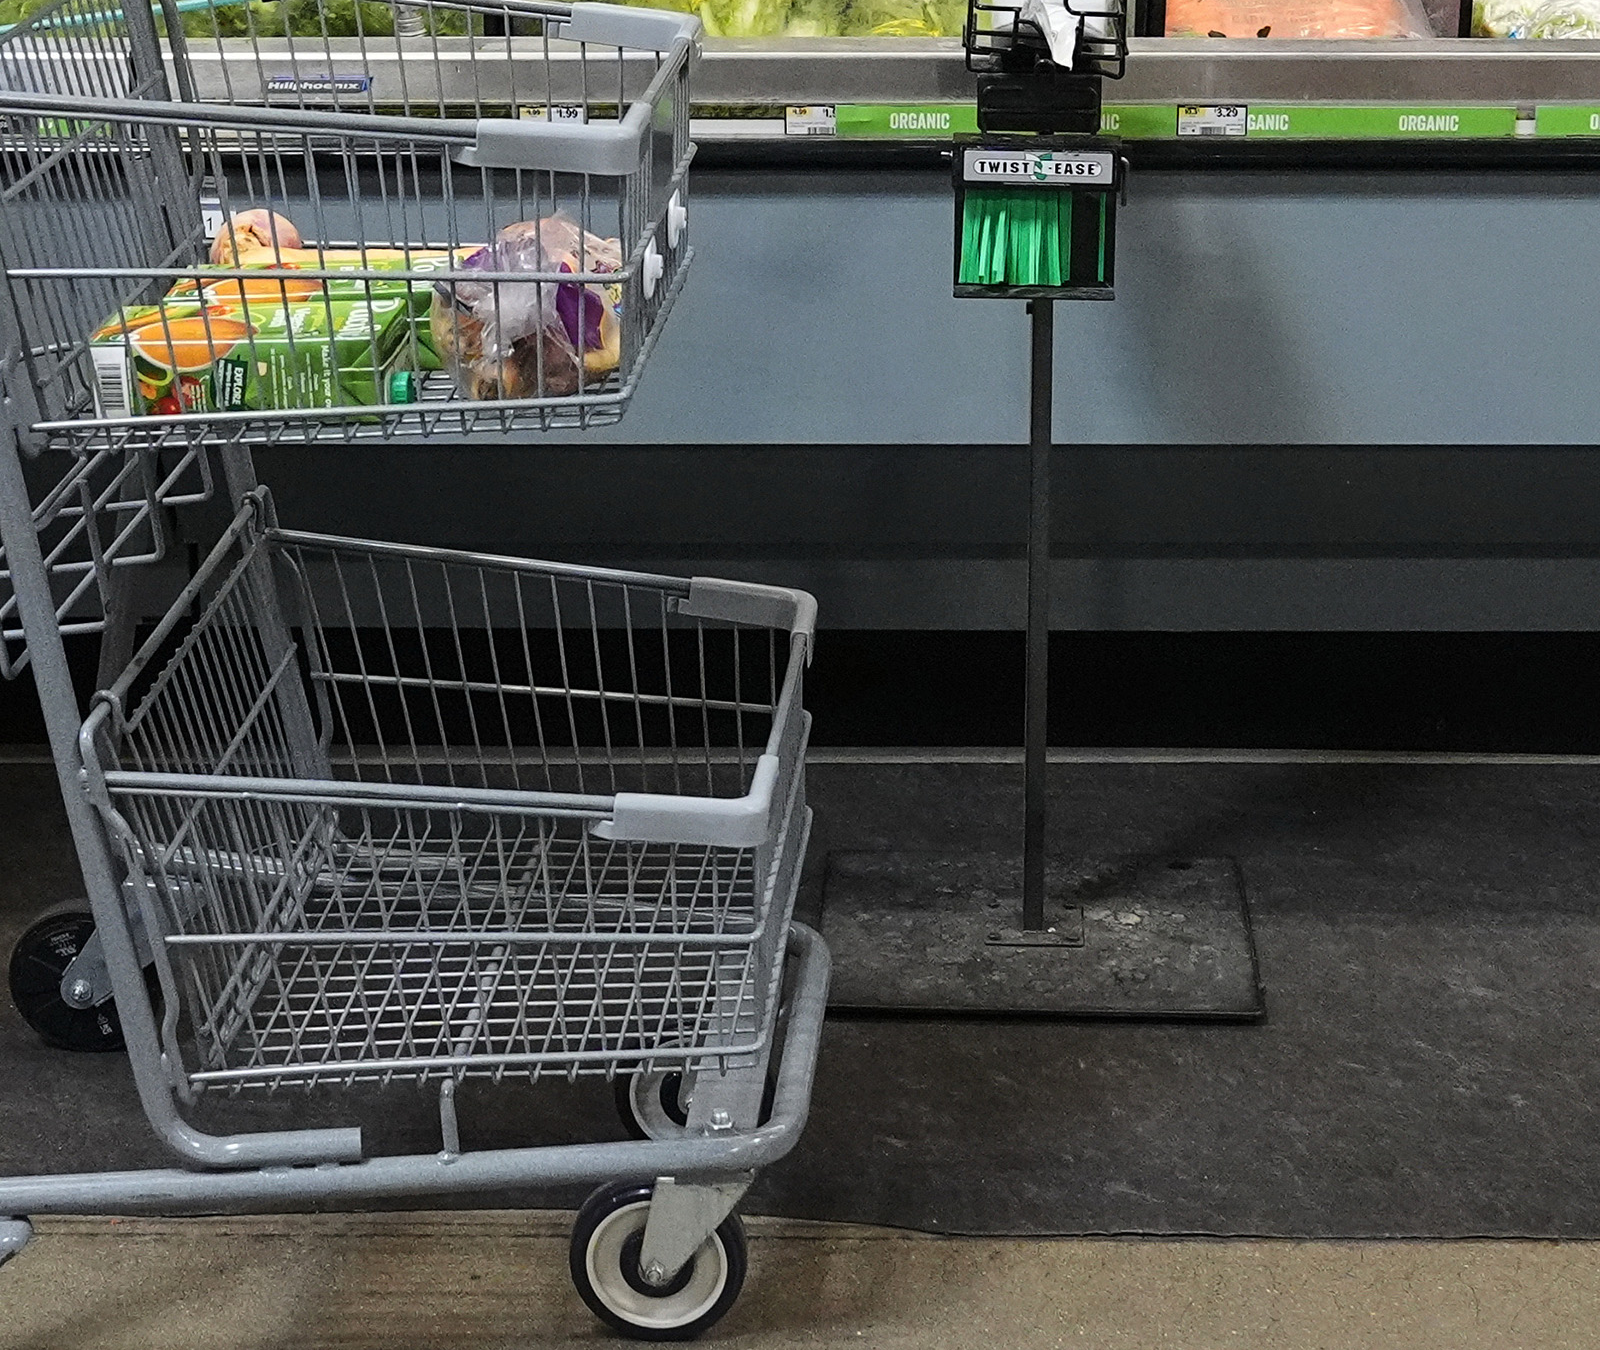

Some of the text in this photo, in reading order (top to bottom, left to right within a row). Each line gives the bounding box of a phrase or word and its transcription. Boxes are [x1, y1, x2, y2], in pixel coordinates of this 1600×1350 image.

[890, 113, 950, 129] ORGANIC
[1248, 114, 1289, 131] GANIC
[1399, 115, 1459, 131] ORGANIC
[978, 162, 1030, 174] TWIST
[231, 366, 244, 406] EXPLORE
[320, 377, 332, 396] your
